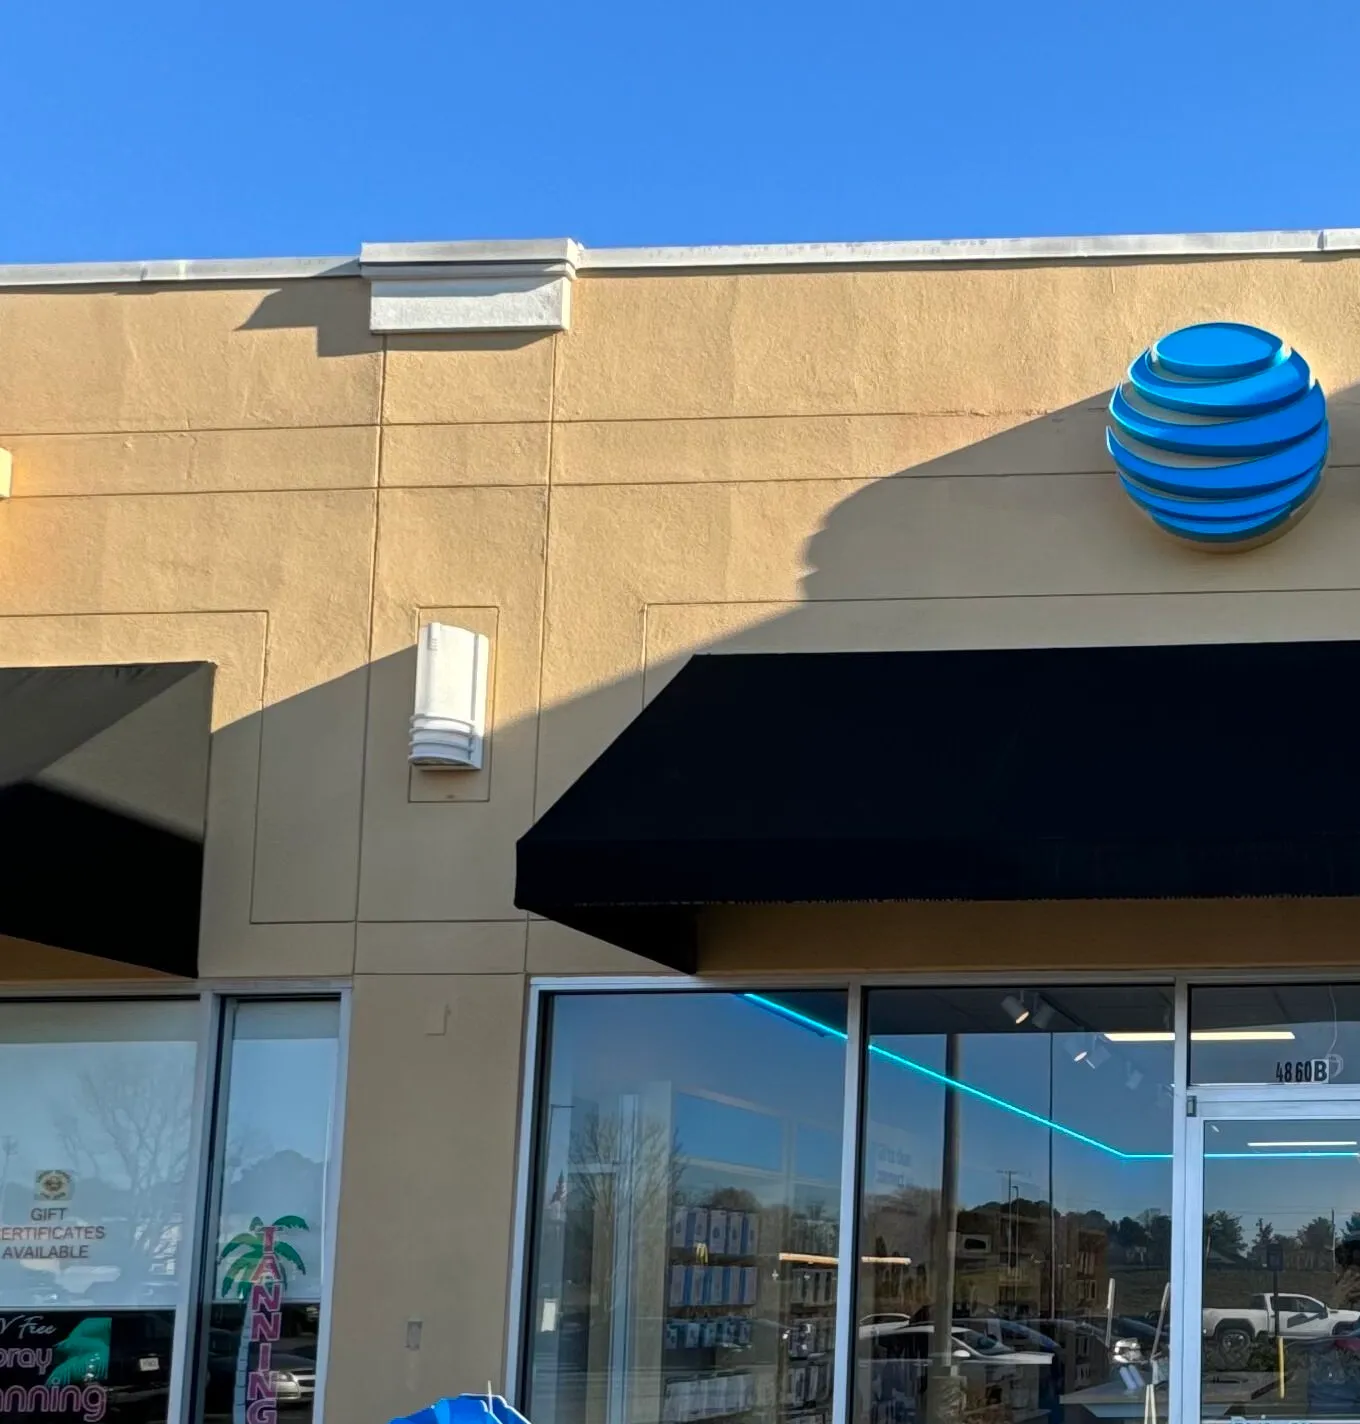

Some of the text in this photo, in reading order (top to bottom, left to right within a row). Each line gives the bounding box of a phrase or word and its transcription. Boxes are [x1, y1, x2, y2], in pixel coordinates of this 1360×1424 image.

[1275, 1060, 1328, 1082] 4860B
[30, 1207, 68, 1221] GIFT
[0, 1226, 105, 1241] ERTIFICATES
[2, 1245, 89, 1259] AVAILABLE
[18, 1315, 57, 1339] Free
[0, 1377, 107, 1422] nning
